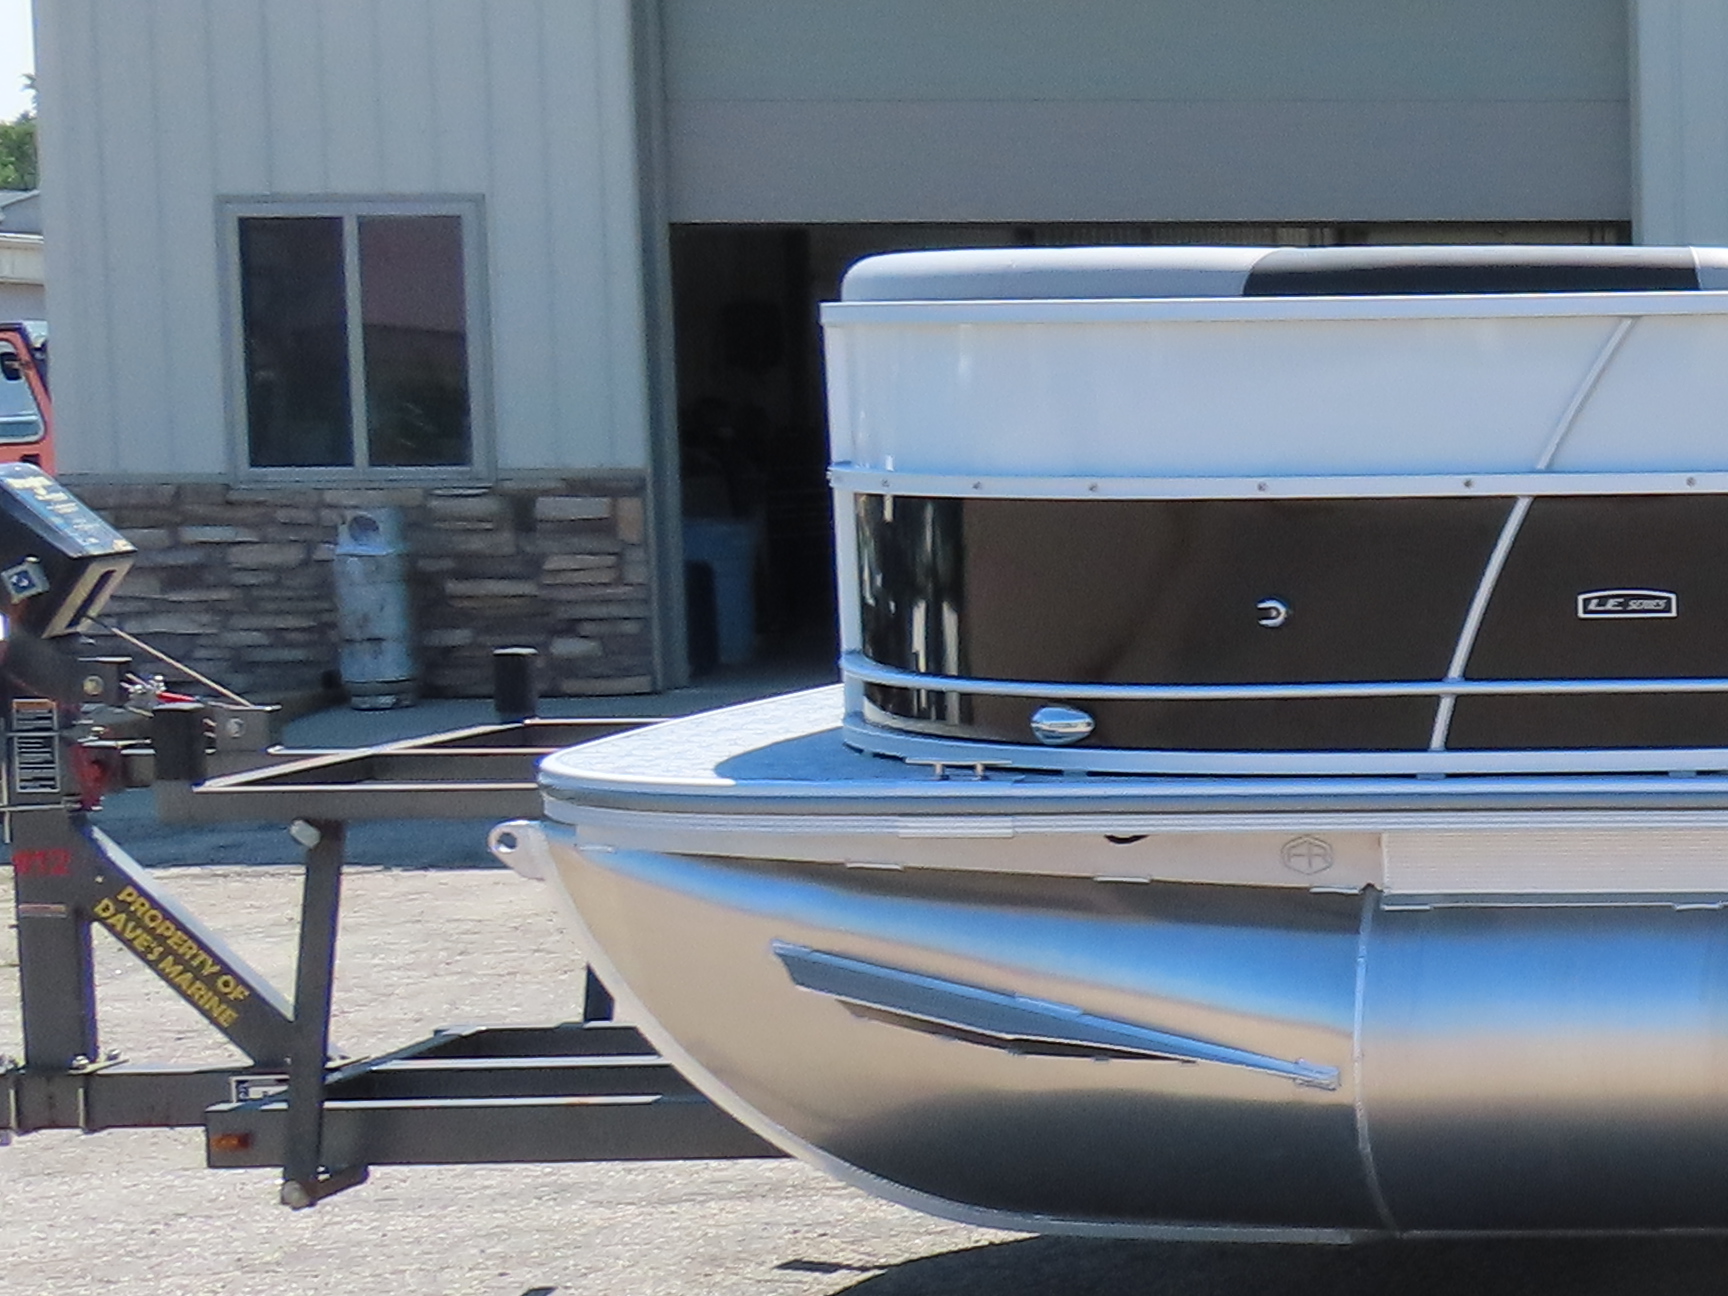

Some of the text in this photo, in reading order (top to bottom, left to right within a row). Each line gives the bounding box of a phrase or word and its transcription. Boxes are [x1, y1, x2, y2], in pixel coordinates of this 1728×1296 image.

[1587, 598, 1625, 610] LE
[93, 897, 239, 1028] DAVE'S MARINE
[116, 885, 250, 1001] PROPERTY OF
